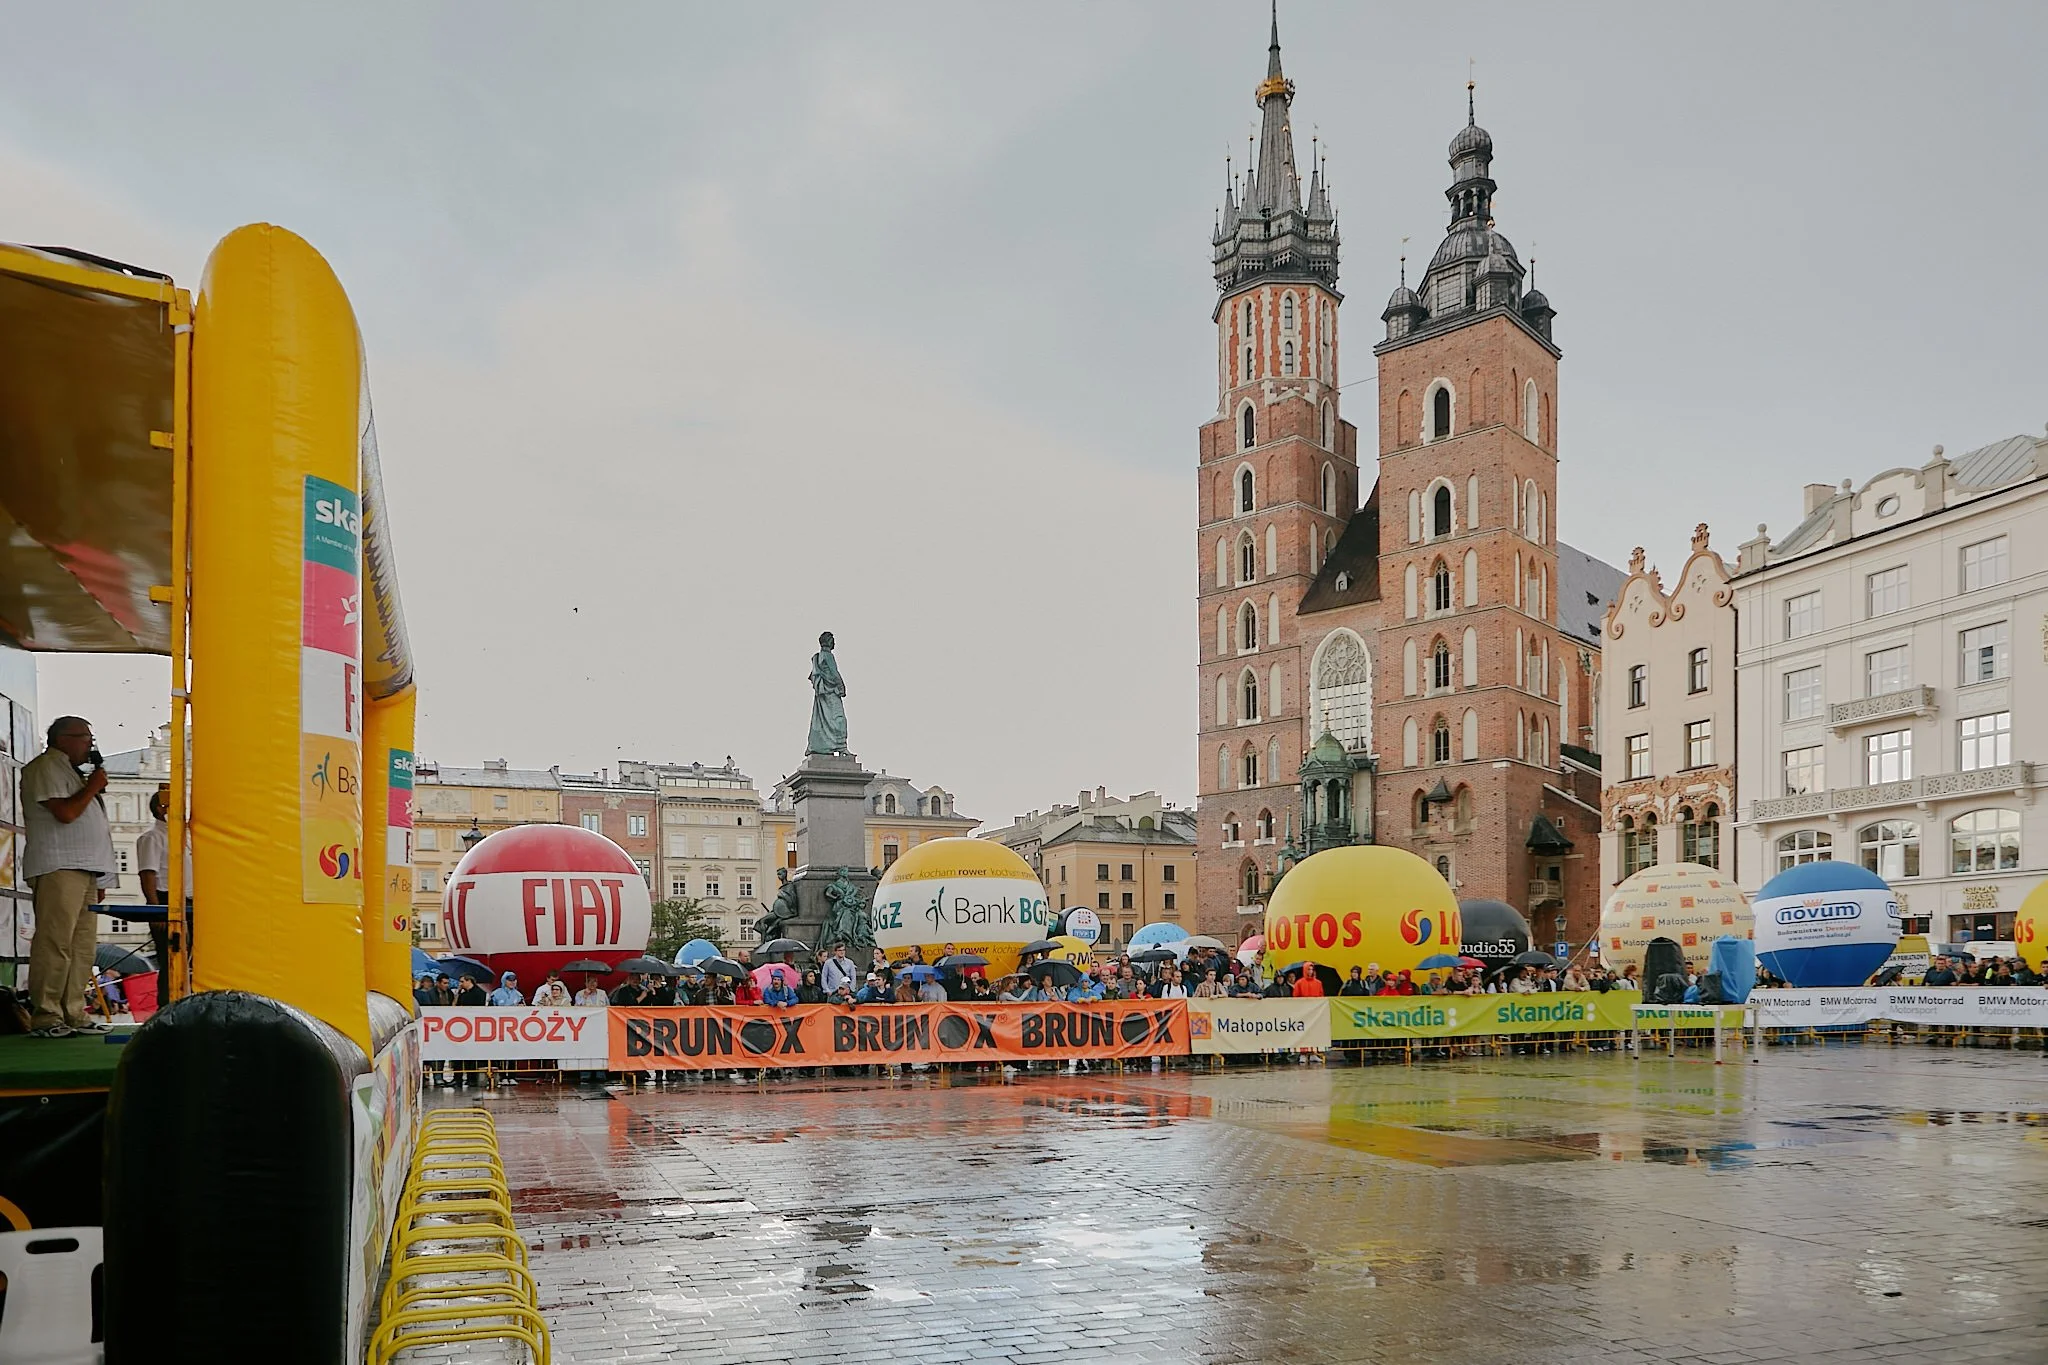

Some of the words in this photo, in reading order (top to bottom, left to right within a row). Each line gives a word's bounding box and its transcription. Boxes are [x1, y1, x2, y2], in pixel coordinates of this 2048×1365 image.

[919, 868, 957, 878] kocham
[958, 868, 987, 877] rower
[522, 878, 624, 947] FIAT
[954, 896, 1016, 924] Bank
[1780, 904, 1855, 922] novum
[1658, 915, 1710, 927] Małopolska
[1268, 911, 1362, 951] LOTOS
[961, 946, 989, 955] rower
[1459, 939, 1516, 954] tudio55
[1558, 943, 1567, 956] P
[1773, 998, 1811, 1007] Motorrad
[1820, 997, 1841, 1006] BMW
[1842, 996, 1877, 1005] Motorrad
[1889, 995, 1916, 1005] BMW
[1917, 995, 1964, 1005] Motorrad
[1978, 996, 2007, 1005] BMW
[1889, 1005, 1938, 1015] Motorsport
[1978, 1006, 2032, 1016] Motorsport
[423, 1010, 588, 1043] PODRÓŻY
[1217, 1018, 1306, 1035] Małopolska
